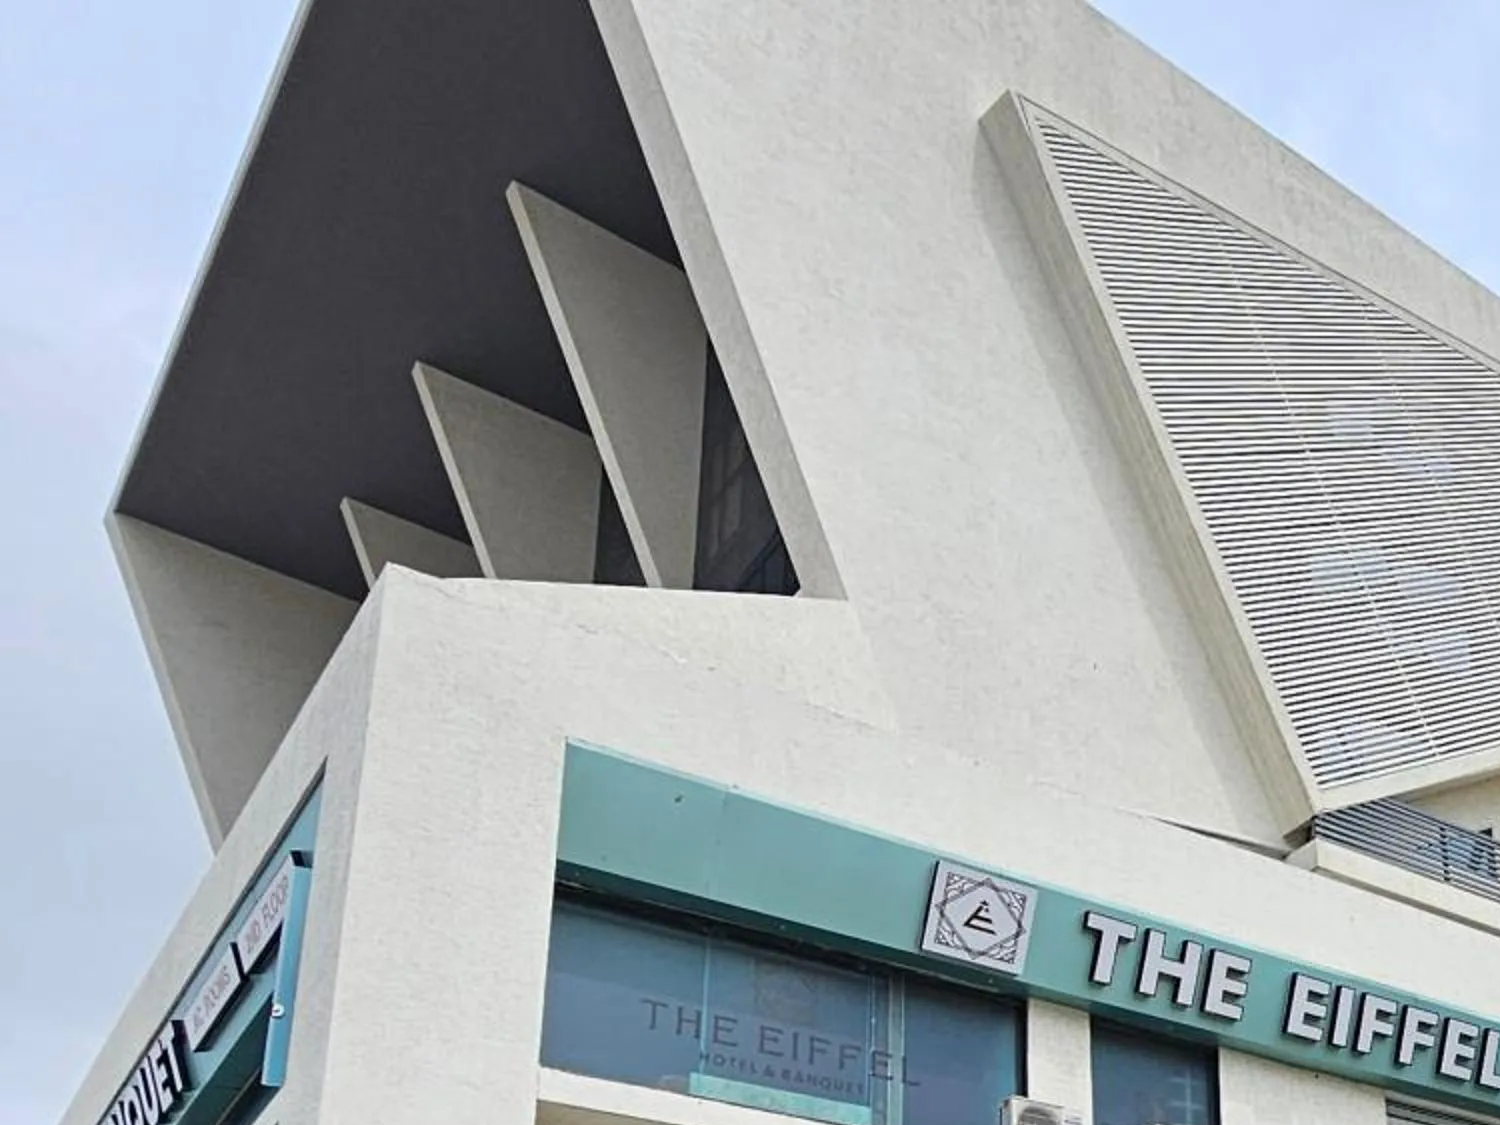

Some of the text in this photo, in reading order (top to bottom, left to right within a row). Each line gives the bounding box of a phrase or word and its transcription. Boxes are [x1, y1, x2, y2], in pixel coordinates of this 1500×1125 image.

[1084, 910, 1252, 1022] THE
[639, 998, 921, 1087] THE EIFFEL
[699, 1051, 758, 1075] HOTEL
[780, 1069, 866, 1095] BANQUET
